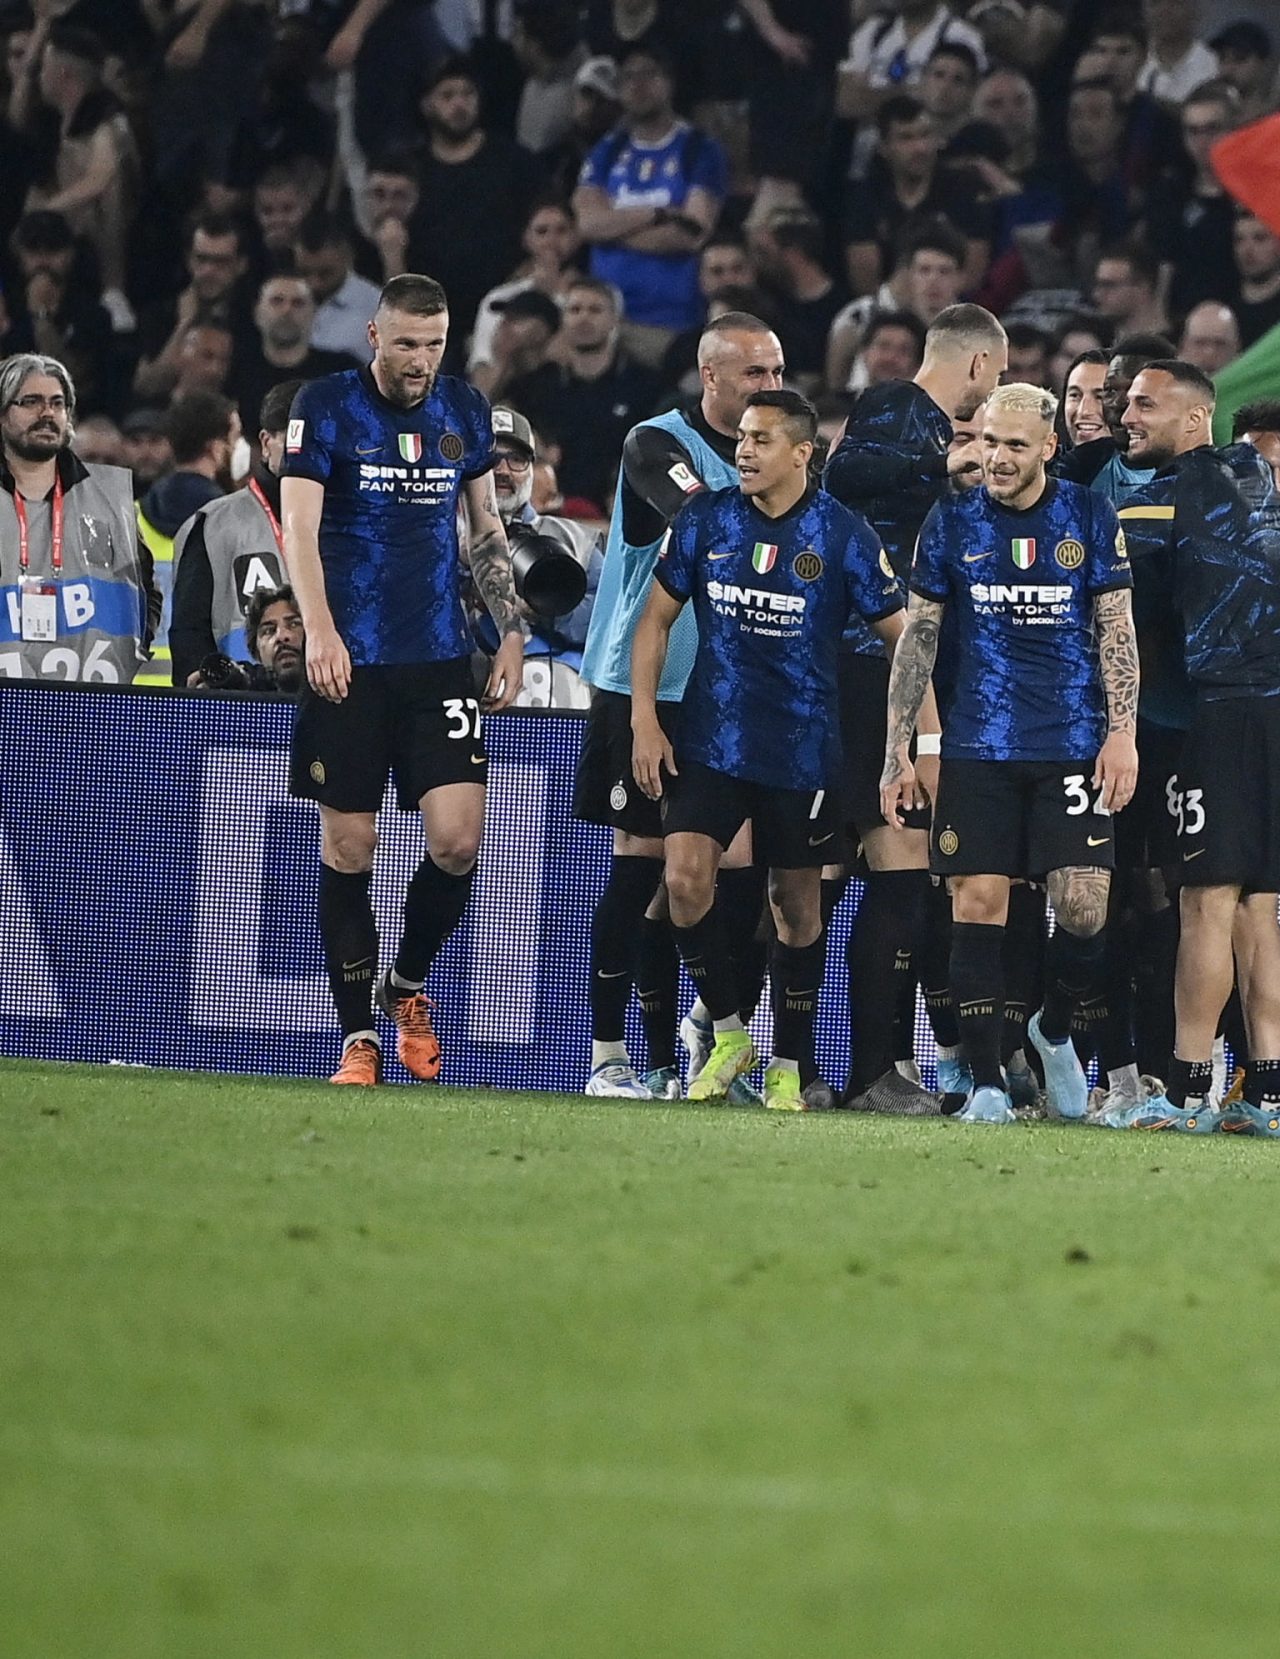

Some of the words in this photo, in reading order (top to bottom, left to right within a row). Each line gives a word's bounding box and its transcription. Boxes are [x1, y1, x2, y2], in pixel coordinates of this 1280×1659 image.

[360, 481, 395, 492] FAN
[402, 482, 455, 492] TOKEN
[1013, 603, 1071, 615] TOKEN
[744, 609, 804, 625] TOKEN
[740, 623, 752, 633] by
[753, 627, 802, 638] socios.com
[443, 698, 480, 739] 37
